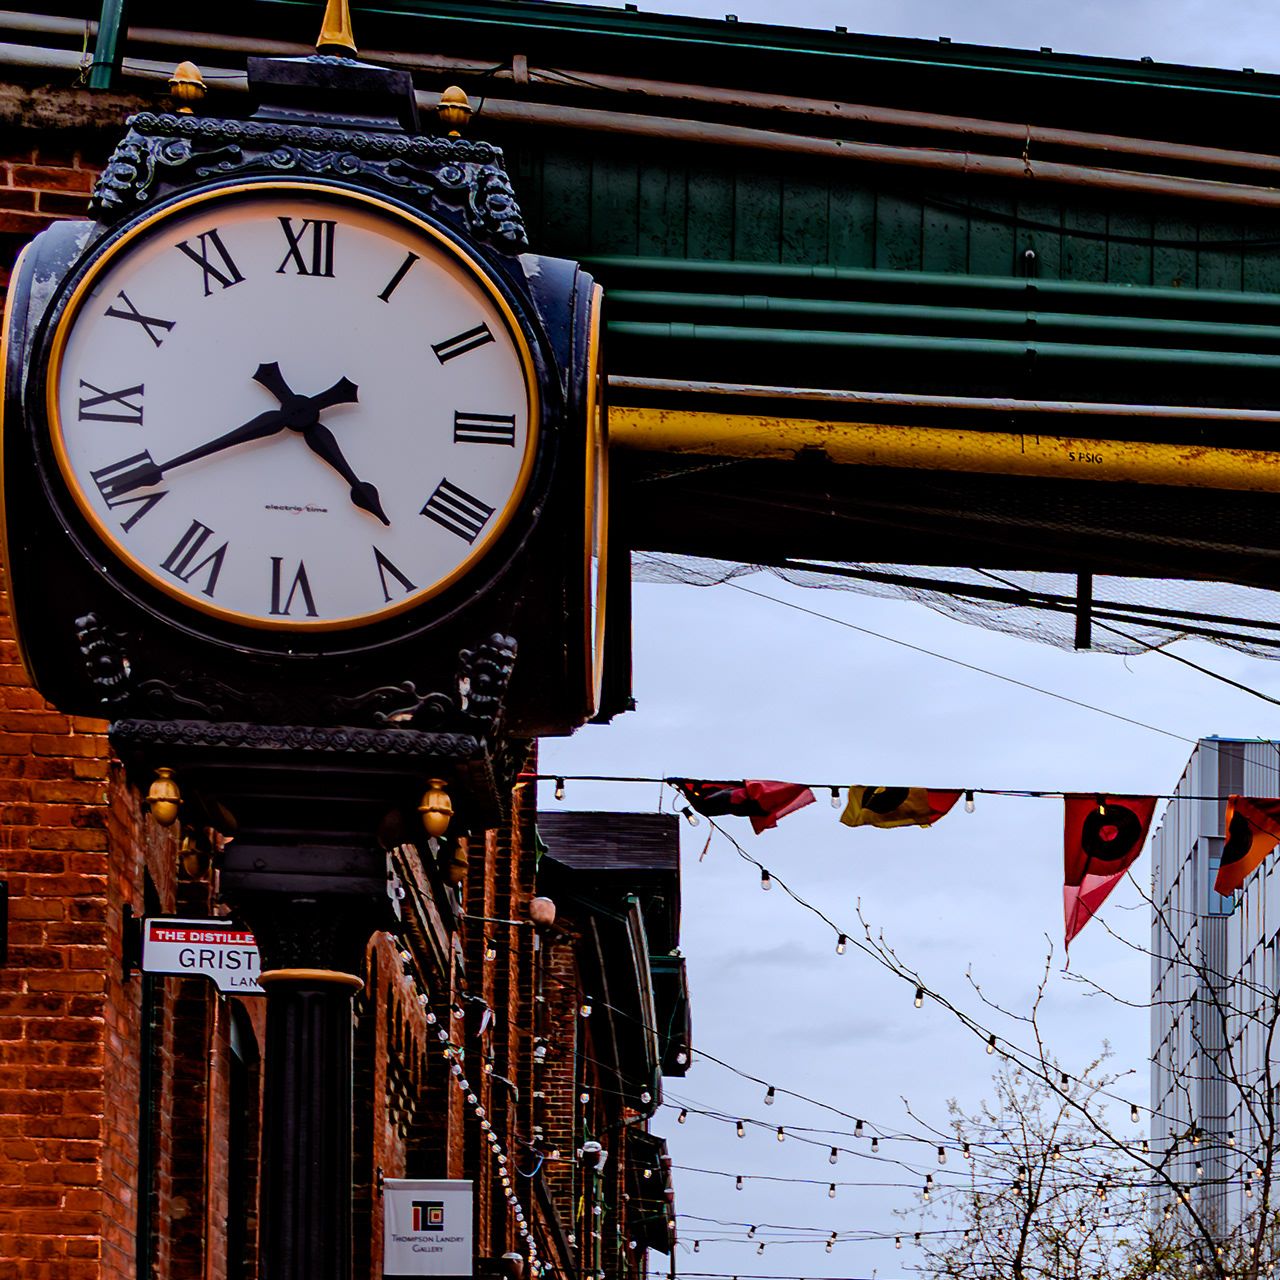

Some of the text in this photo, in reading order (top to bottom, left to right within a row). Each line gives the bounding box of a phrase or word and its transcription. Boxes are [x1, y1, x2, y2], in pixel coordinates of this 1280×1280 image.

[276, 217, 337, 278] XII
[104, 290, 176, 348] X
[264, 504, 302, 512] electric
[156, 931, 255, 944] THE DISTILLE
[179, 948, 258, 970] GRIST
[230, 977, 258, 987] LAN
[391, 1234, 465, 1243] THOMPSON LANDRY
[412, 1244, 443, 1253] GALLERY
